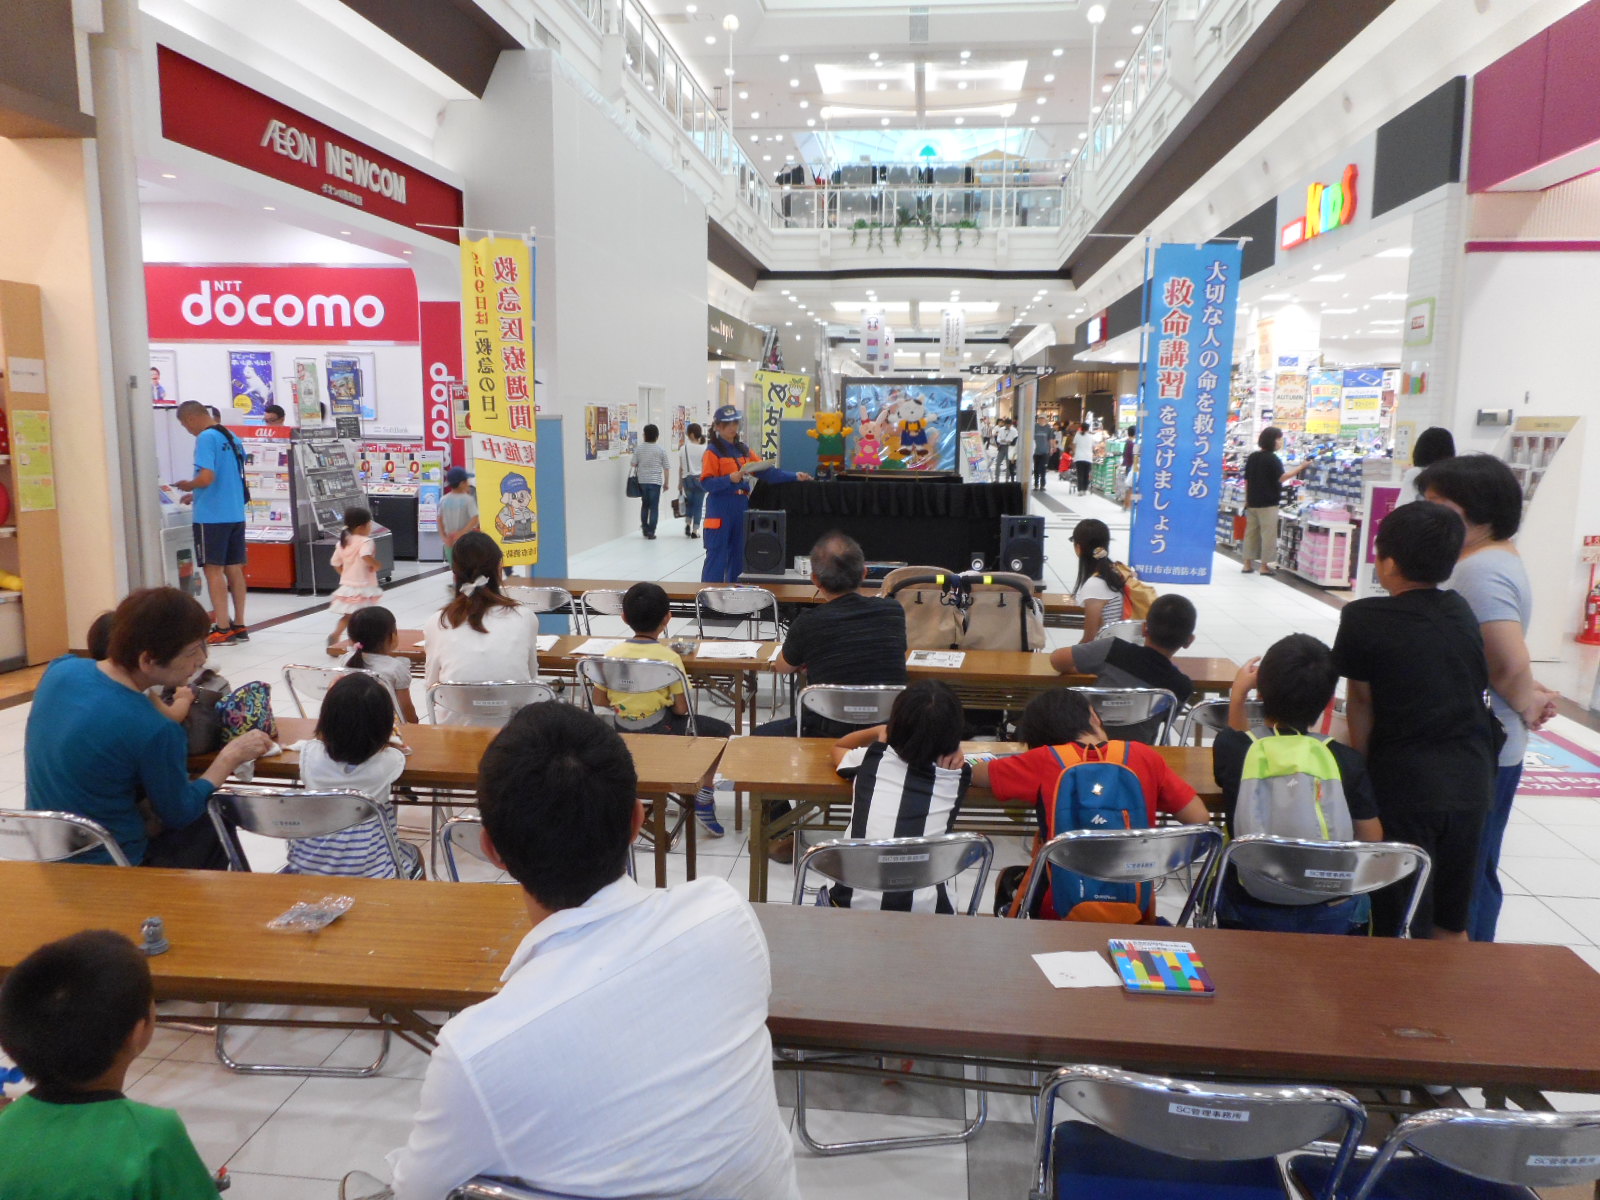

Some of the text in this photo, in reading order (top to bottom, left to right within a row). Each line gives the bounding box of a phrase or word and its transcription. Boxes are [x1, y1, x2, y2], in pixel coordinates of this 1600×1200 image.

[325, 141, 406, 204] NEWCOM
[1306, 164, 1359, 240] KIDS
[181, 280, 385, 327] docomo
[214, 280, 242, 292] NTT
[1188, 260, 1228, 499] 大切な人の命を救うため
[254, 428, 276, 438] au
[1175, 1105, 1242, 1119] SC管理事務所
